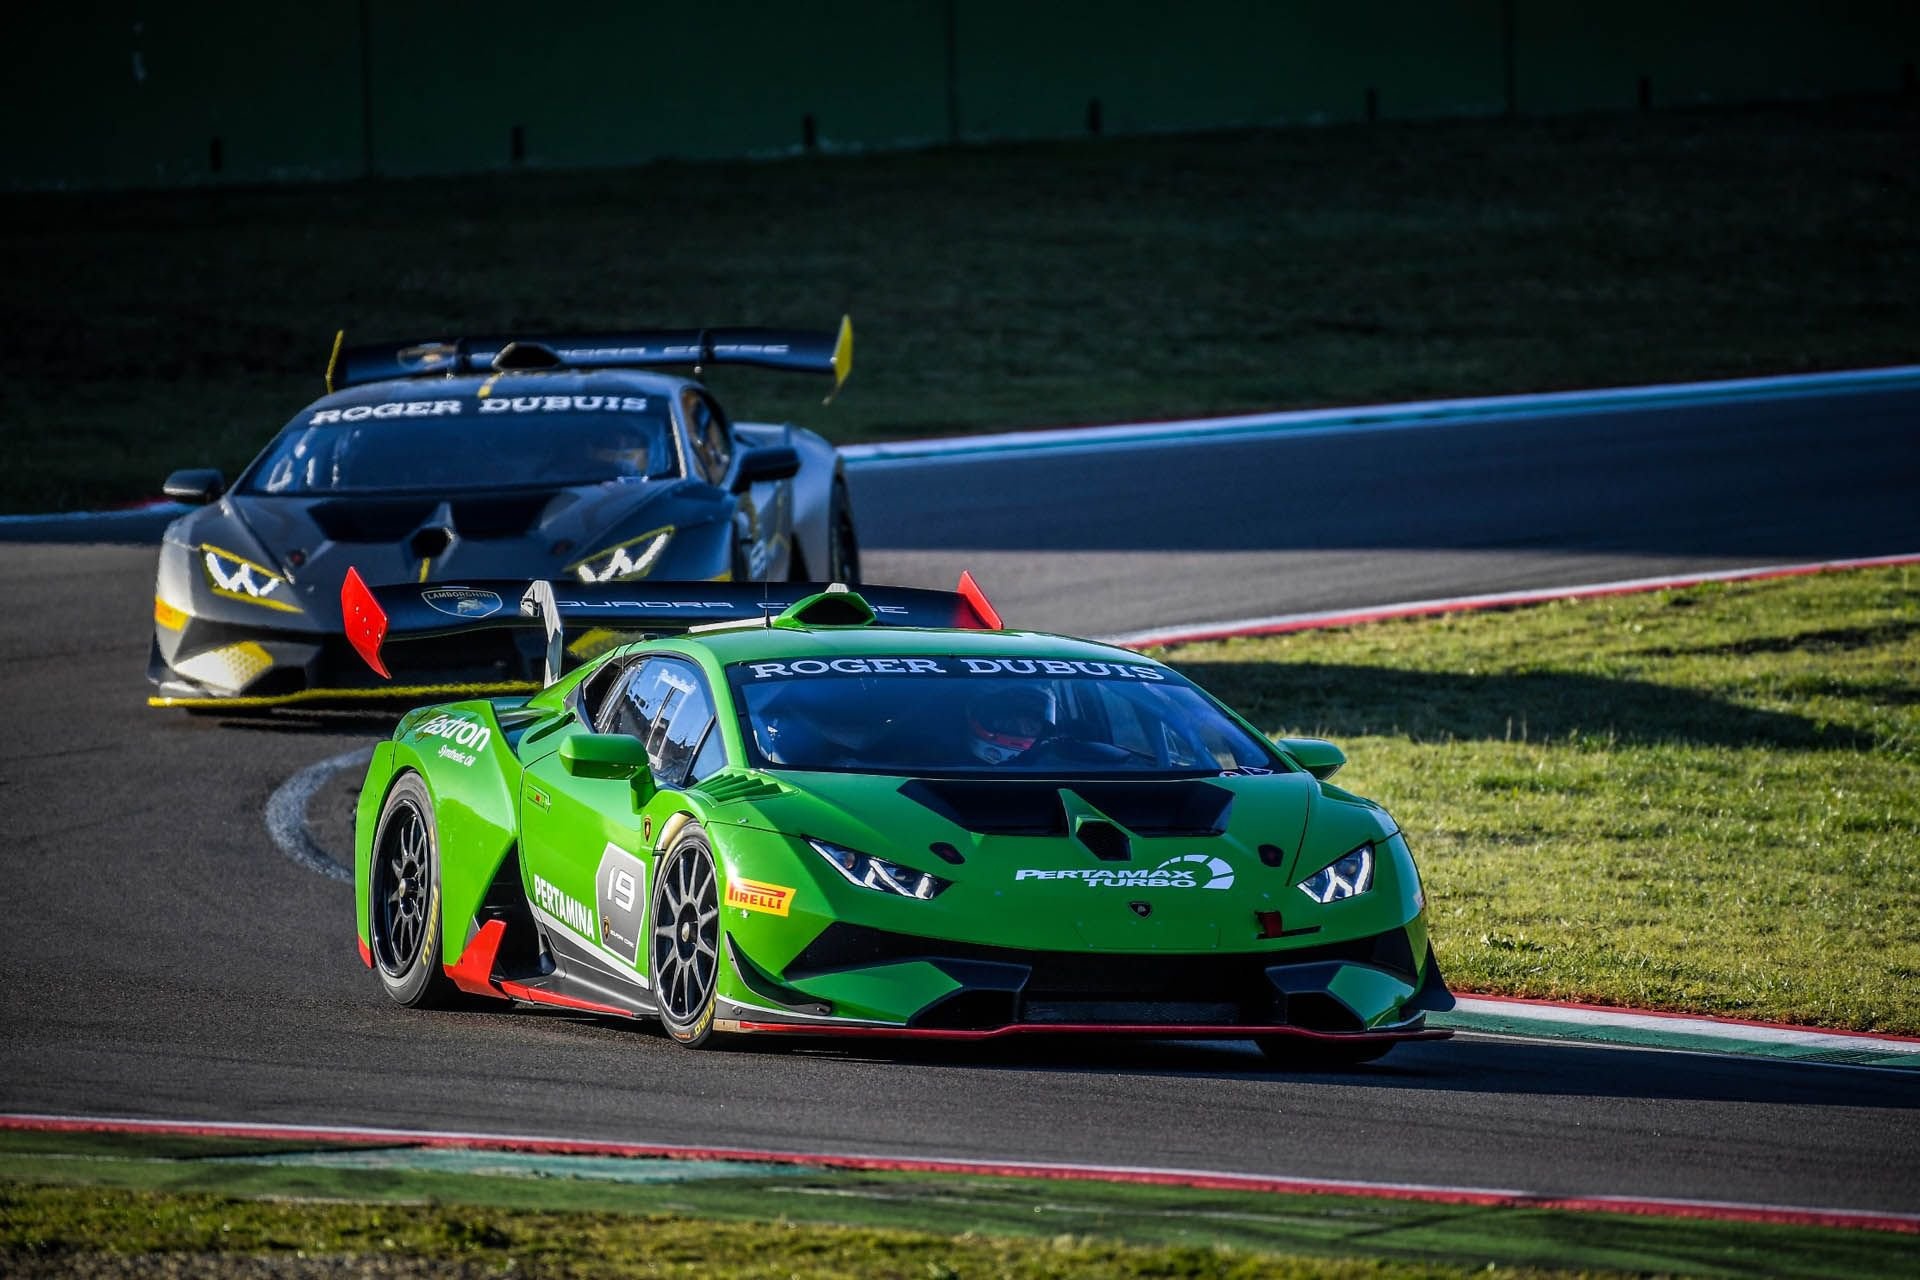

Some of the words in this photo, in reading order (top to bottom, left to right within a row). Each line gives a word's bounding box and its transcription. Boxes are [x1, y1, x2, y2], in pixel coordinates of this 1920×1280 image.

[309, 400, 462, 425] ROGER
[478, 396, 648, 413] DUBUIS
[554, 600, 735, 609] QUADRA
[749, 658, 947, 678] ROGER
[960, 658, 1165, 680] DUBUIS
[1015, 869, 1194, 881] PERTAMAX
[1083, 878, 1197, 888] TURBO
[607, 866, 636, 913] 19
[728, 880, 786, 910] PIRELLI
[534, 873, 595, 941] PERTAMINA
